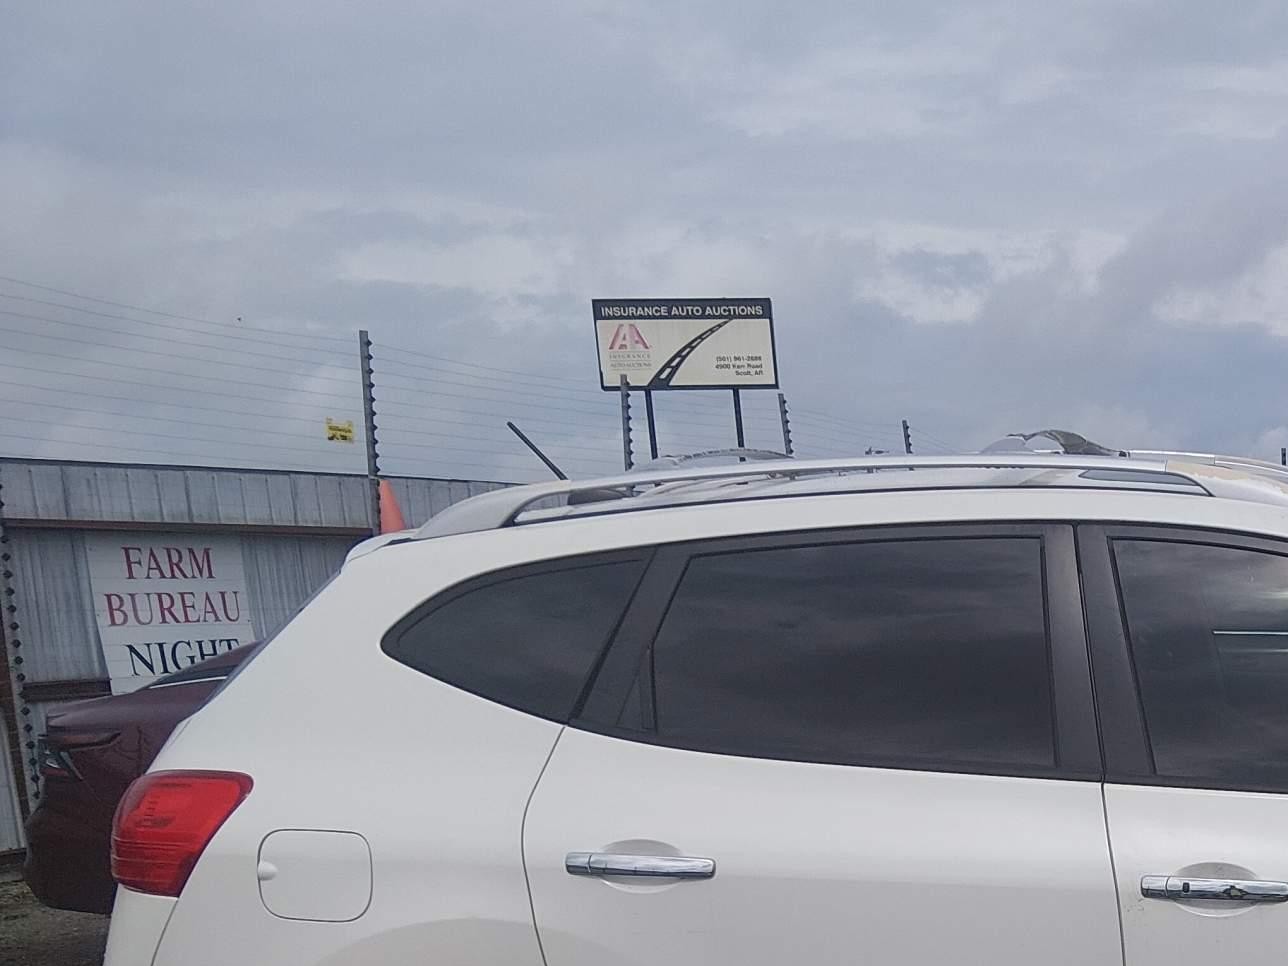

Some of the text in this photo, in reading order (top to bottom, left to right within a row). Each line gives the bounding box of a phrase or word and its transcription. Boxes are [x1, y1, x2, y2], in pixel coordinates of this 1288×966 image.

[601, 305, 763, 317] INSURANCE AUTO AUCTIONS
[121, 546, 216, 580] FARM
[104, 591, 240, 627] BUREAU
